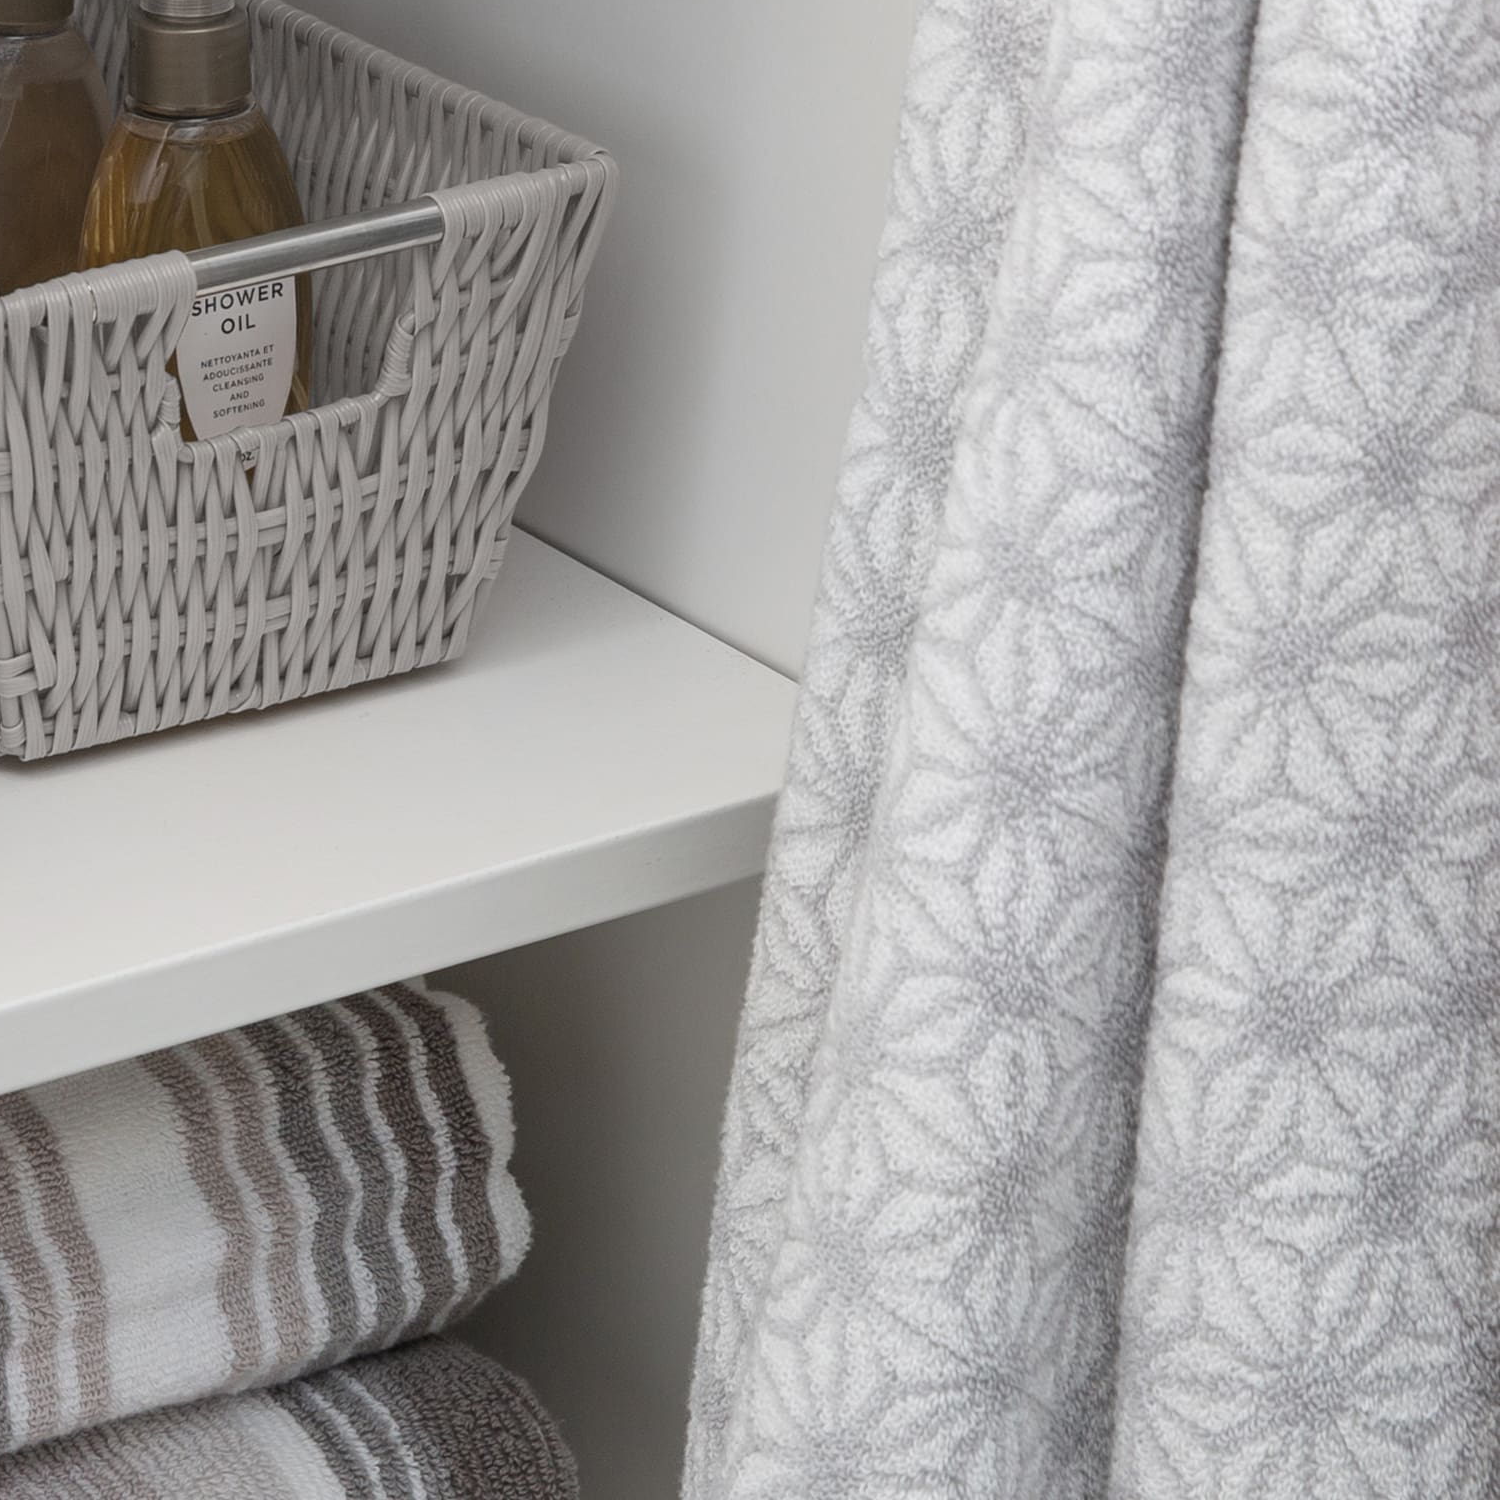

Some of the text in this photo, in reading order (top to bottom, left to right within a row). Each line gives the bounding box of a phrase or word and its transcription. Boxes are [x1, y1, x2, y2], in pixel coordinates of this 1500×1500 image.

[192, 282, 284, 317] SHOWER
[221, 313, 256, 335] OIL
[263, 344, 274, 354] ET
[203, 357, 273, 381] ADOUCISSANTE
[213, 373, 264, 392] CLEANSING
[230, 390, 249, 401] AND
[213, 398, 265, 419] SOFTENING
